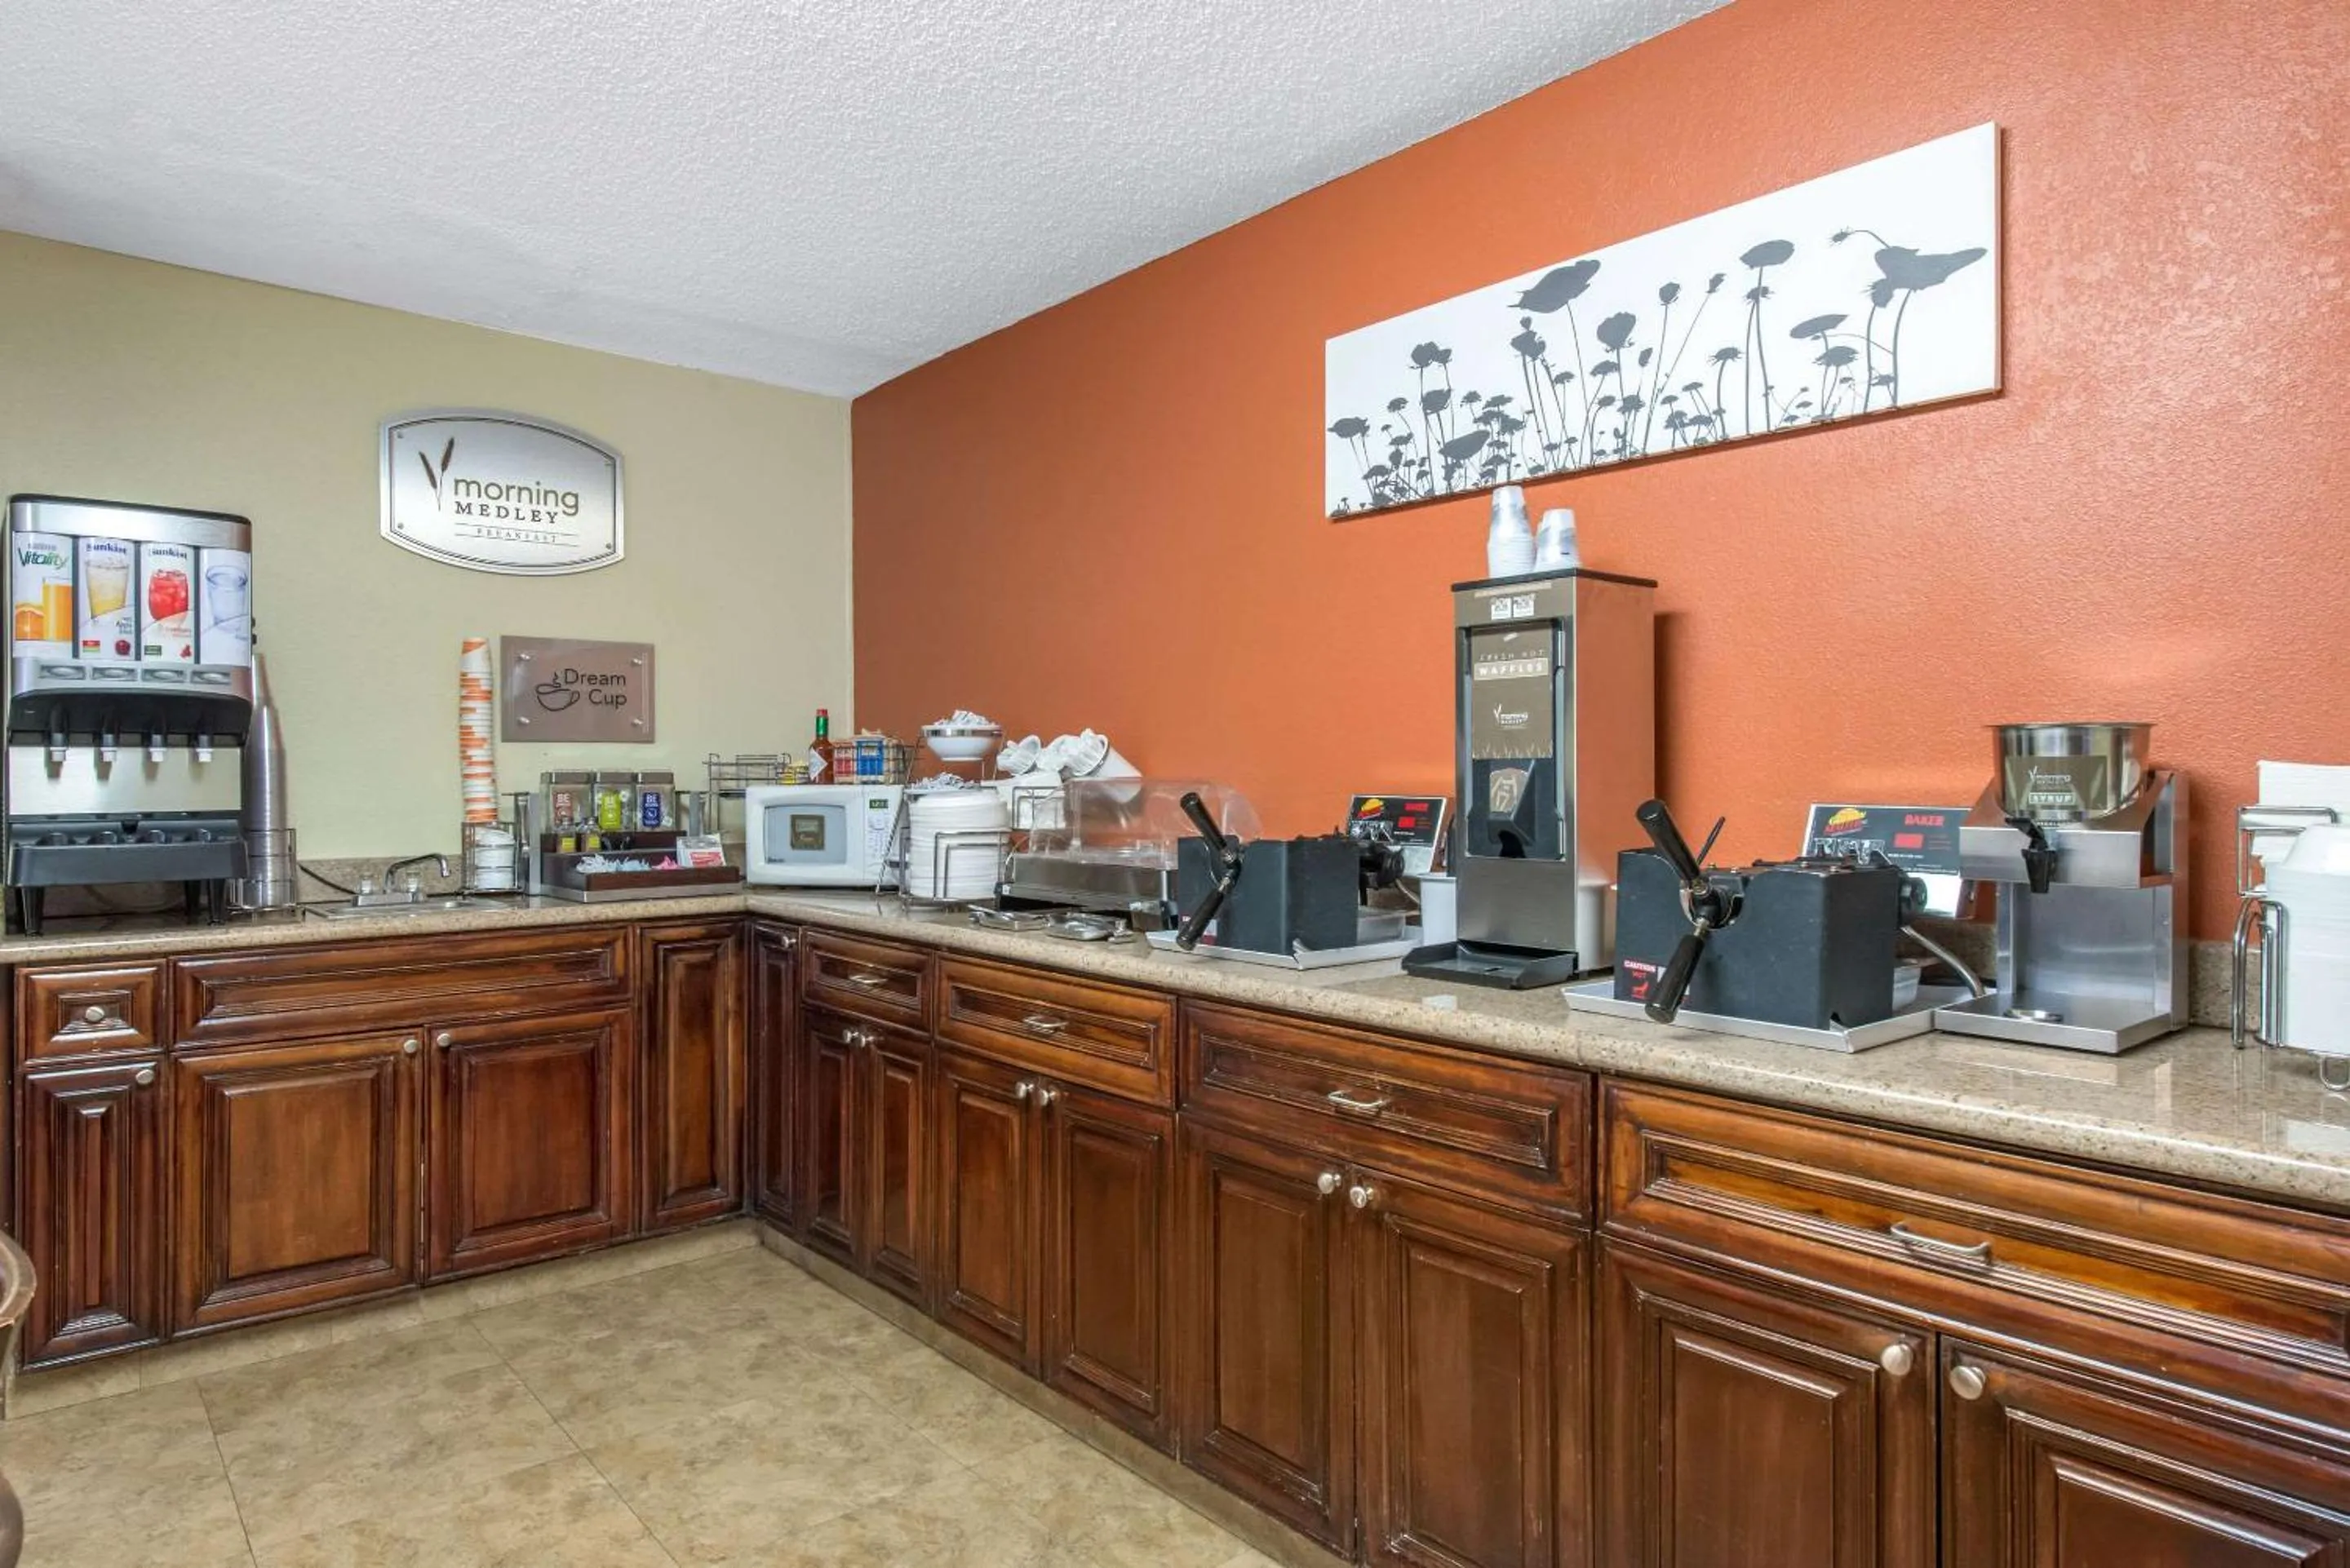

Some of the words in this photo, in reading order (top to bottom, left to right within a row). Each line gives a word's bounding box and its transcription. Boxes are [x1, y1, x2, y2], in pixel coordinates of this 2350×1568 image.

[454, 477, 579, 516] morning
[454, 501, 559, 525] MEDLEY
[18, 547, 69, 570] Vitality
[564, 668, 627, 686] Dream
[1478, 662, 1544, 676] WAFFLES
[588, 689, 627, 710] Cup
[2031, 794, 2072, 803] SYRUP
[1624, 959, 1656, 973] CAUTION
